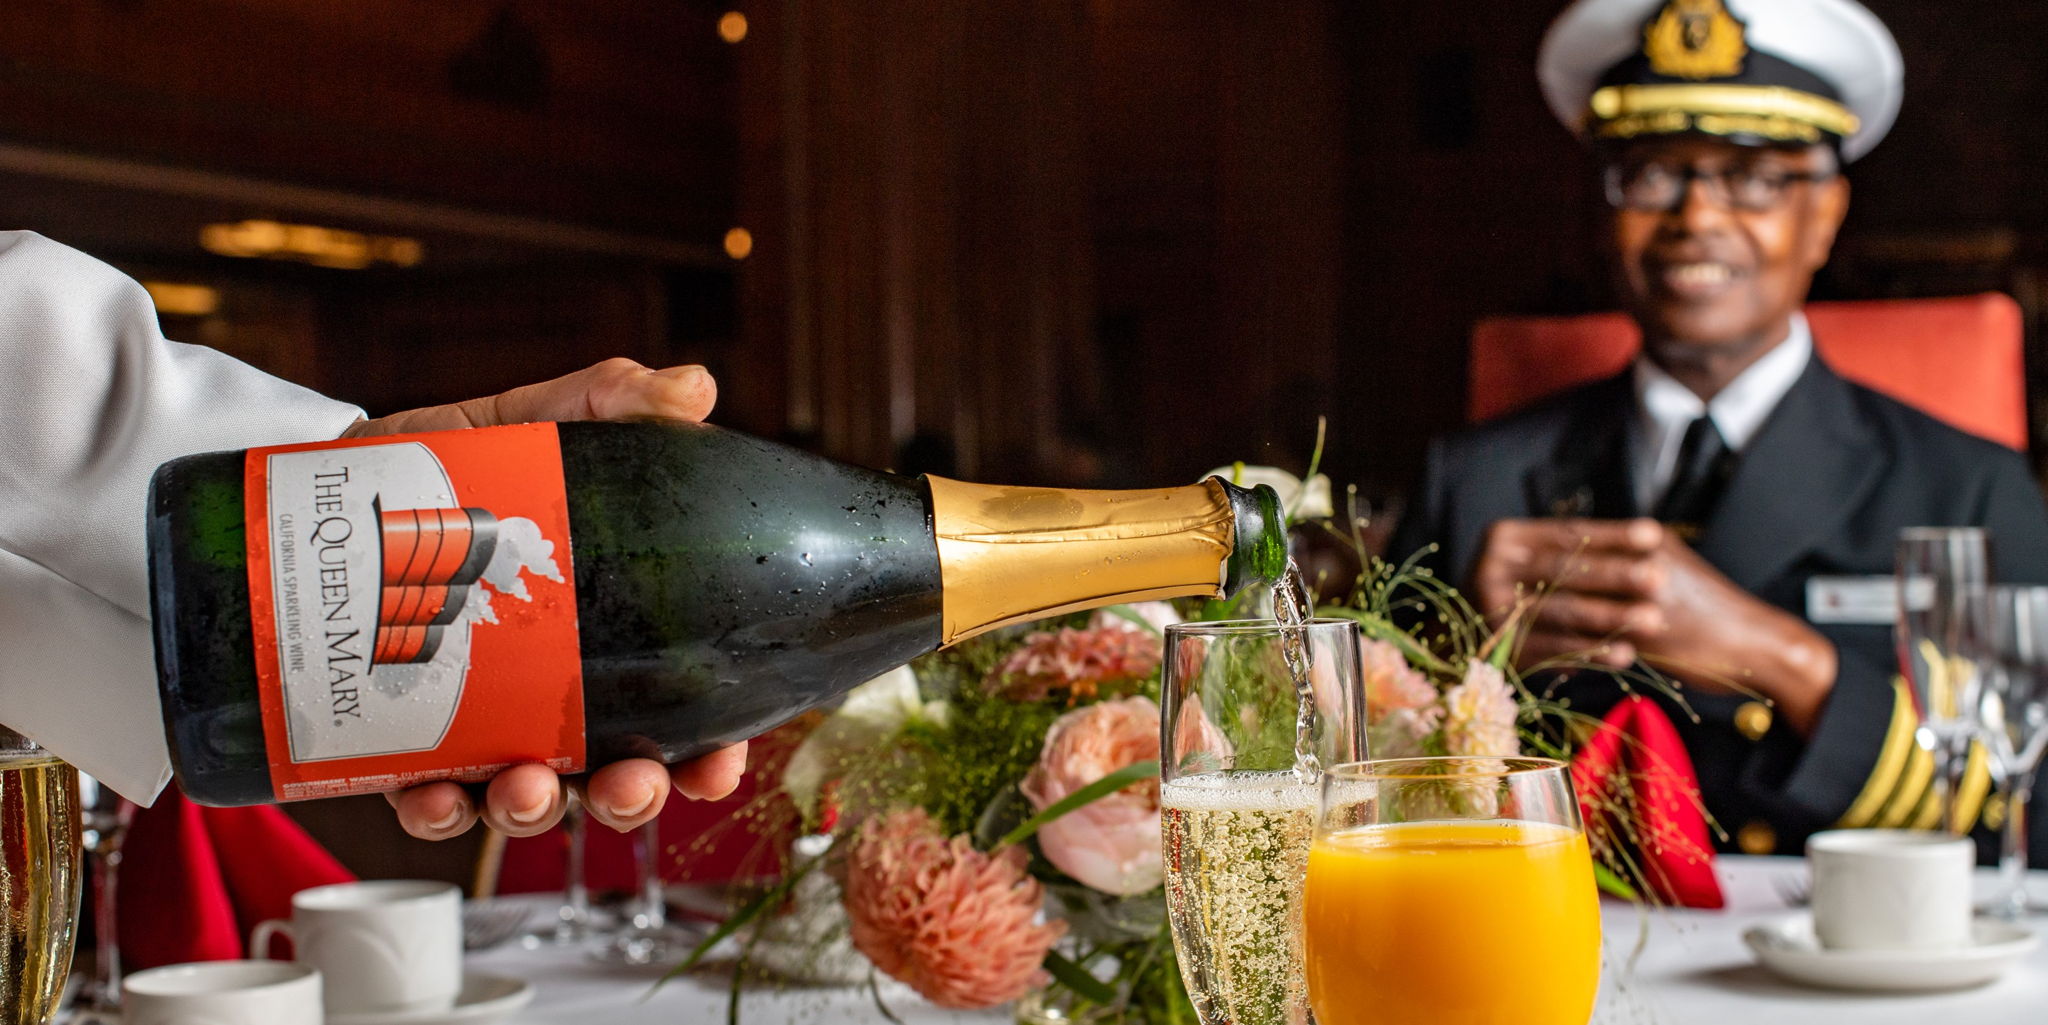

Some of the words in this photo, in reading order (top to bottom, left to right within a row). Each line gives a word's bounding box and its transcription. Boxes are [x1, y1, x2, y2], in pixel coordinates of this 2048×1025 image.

[314, 466, 349, 514] THE
[279, 513, 296, 575] CALIFORNIA
[310, 517, 352, 621] QUEEN
[283, 576, 301, 640] SPARKLING
[289, 641, 305, 673] WINE
[283, 778, 345, 788] GOVERNMENT
